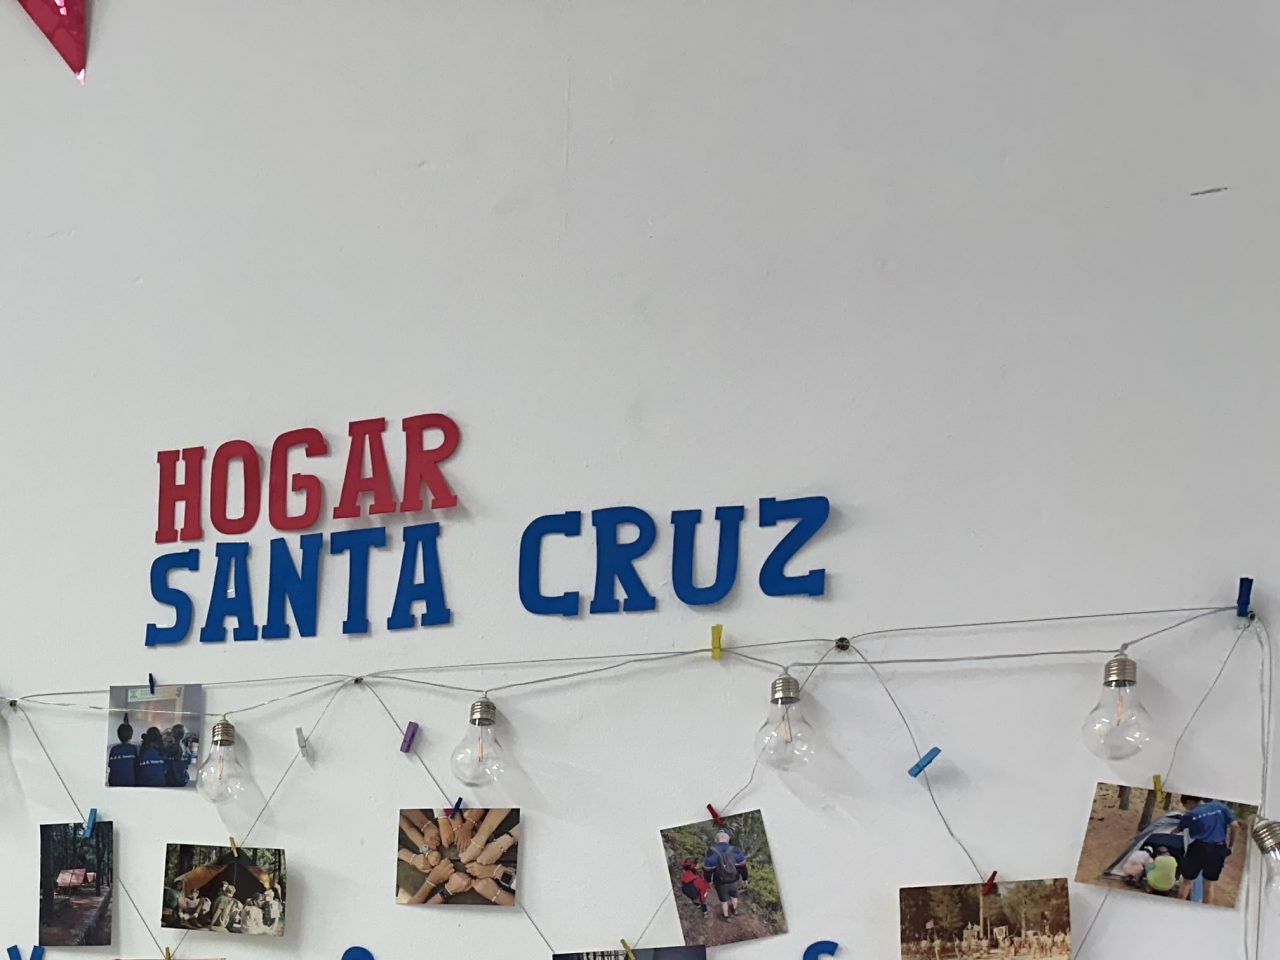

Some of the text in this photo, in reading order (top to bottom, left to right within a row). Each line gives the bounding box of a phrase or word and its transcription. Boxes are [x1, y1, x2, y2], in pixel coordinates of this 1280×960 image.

[155, 412, 462, 543] HOGAR
[145, 496, 831, 647] SANTA CRUZ
